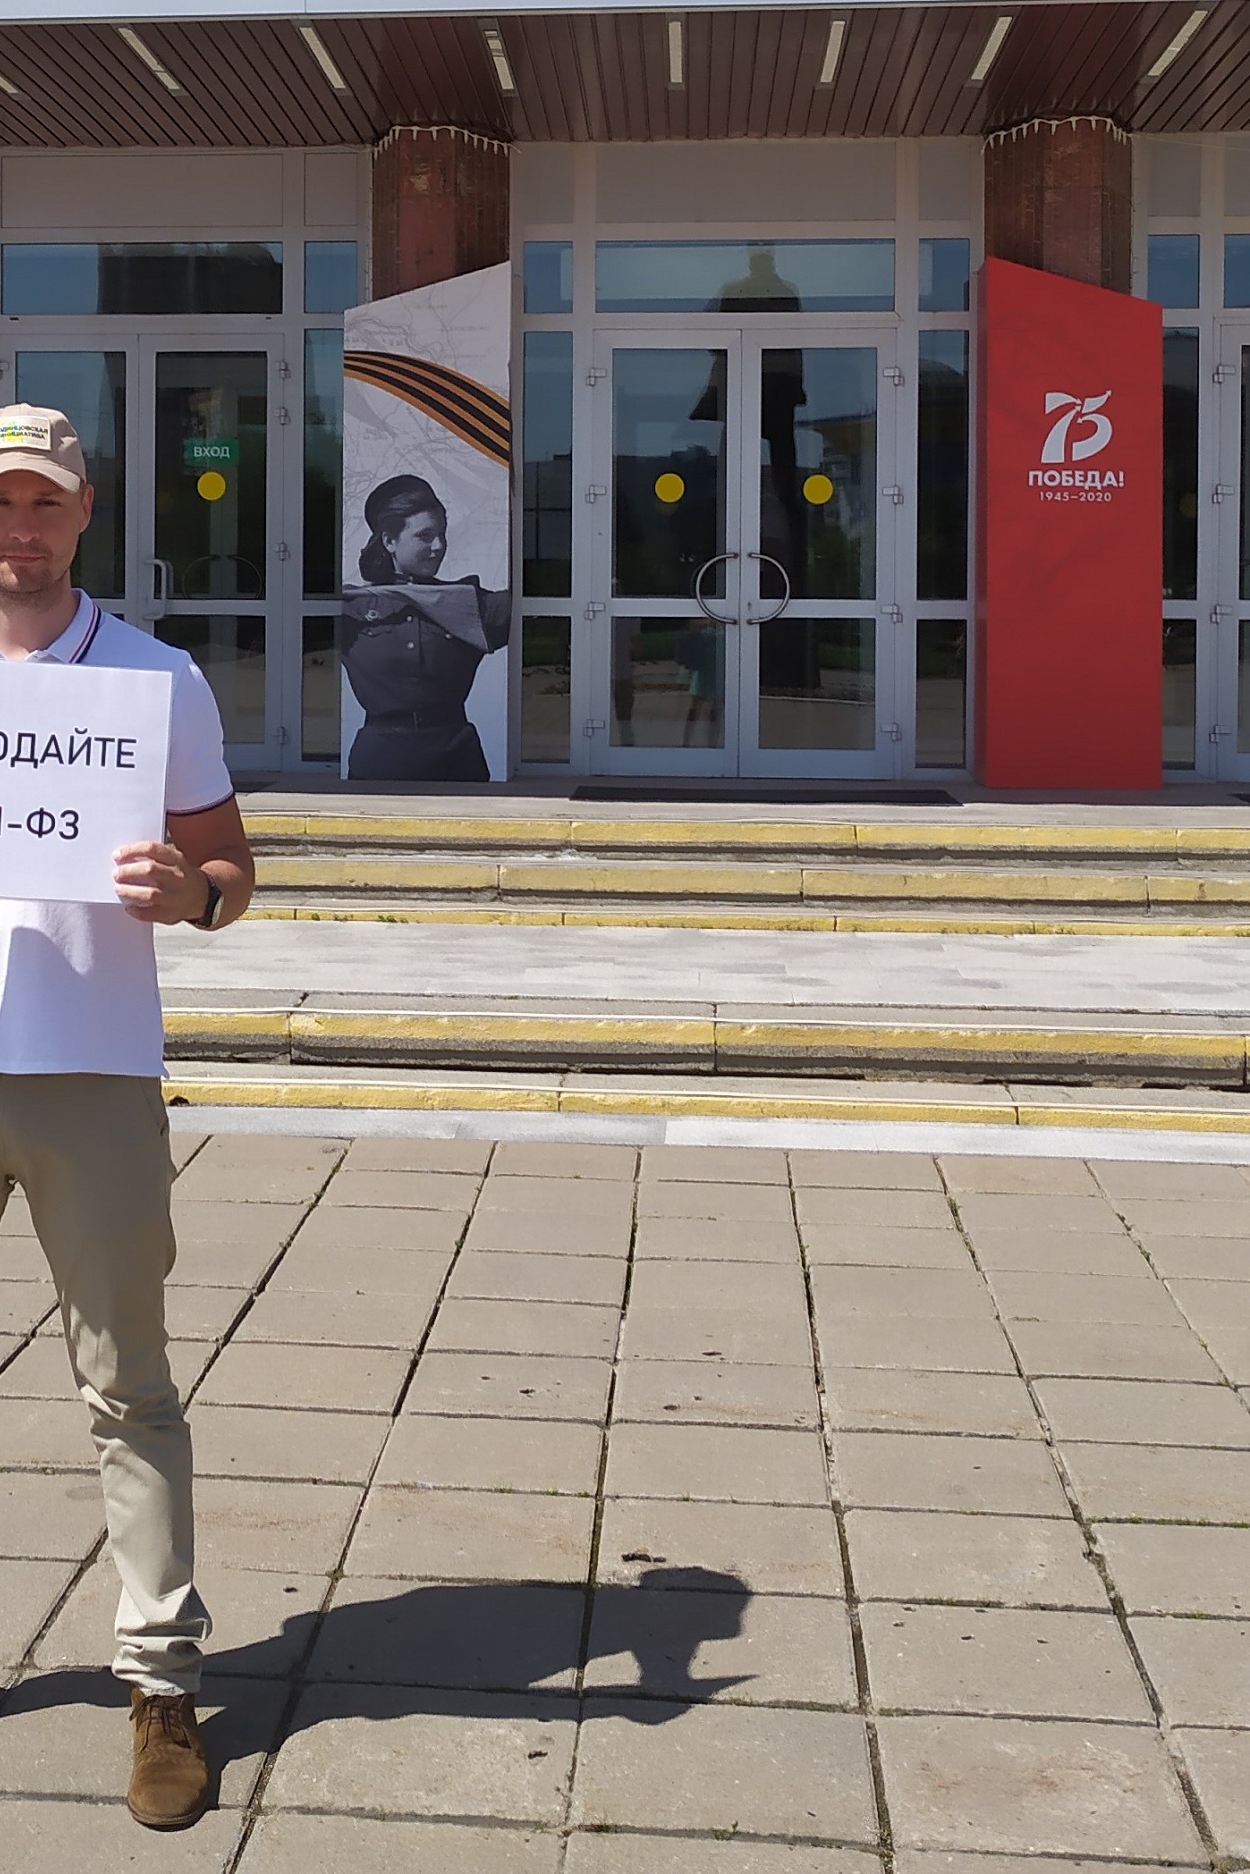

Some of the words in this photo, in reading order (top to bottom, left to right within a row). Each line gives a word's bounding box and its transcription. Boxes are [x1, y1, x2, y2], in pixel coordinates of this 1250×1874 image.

[1040, 389, 1113, 464] 75
[193, 446, 230, 459] ВХОД
[1028, 470, 1125, 490] ПОБЕДА!
